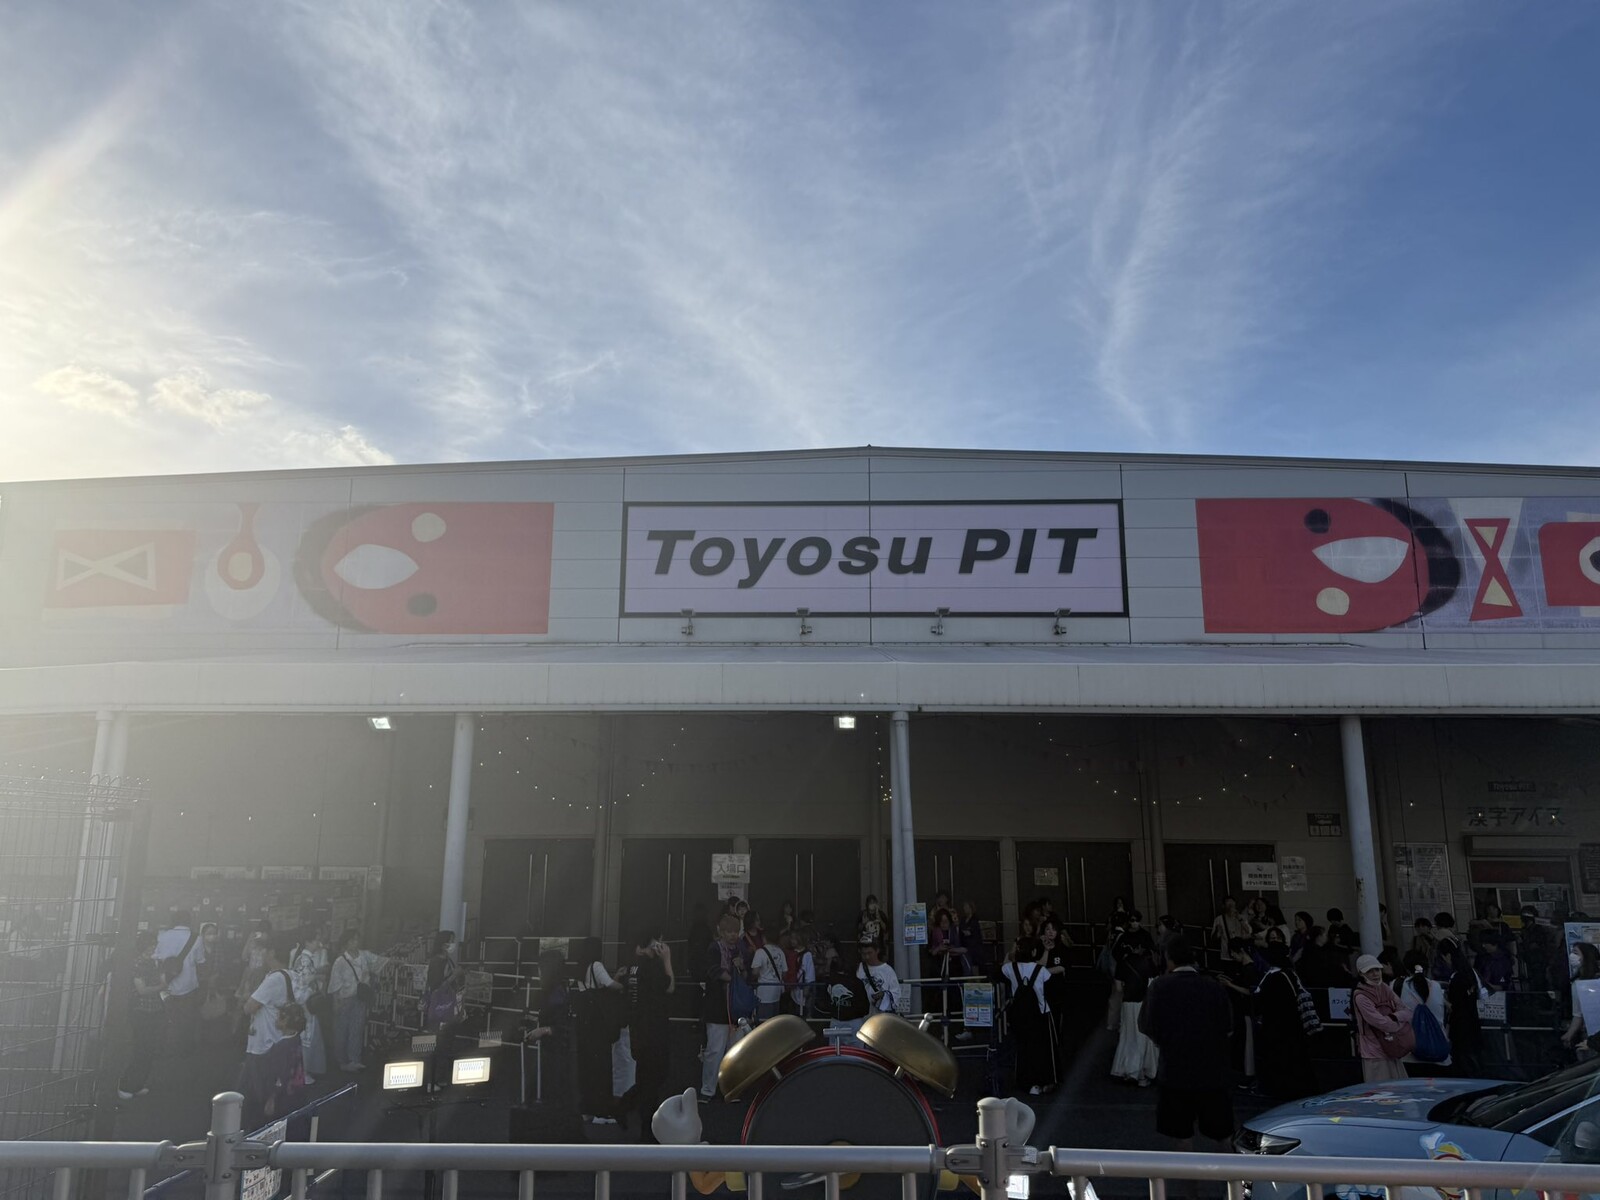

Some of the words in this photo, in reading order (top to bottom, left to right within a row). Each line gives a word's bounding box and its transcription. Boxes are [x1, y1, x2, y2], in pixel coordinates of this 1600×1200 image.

[646, 529, 933, 589] Toyosu
[959, 528, 1099, 574] PIT
[1467, 806, 1566, 826] 漢字アイス
[717, 863, 746, 874] 入場口
[1053, 956, 1061, 965] 8
